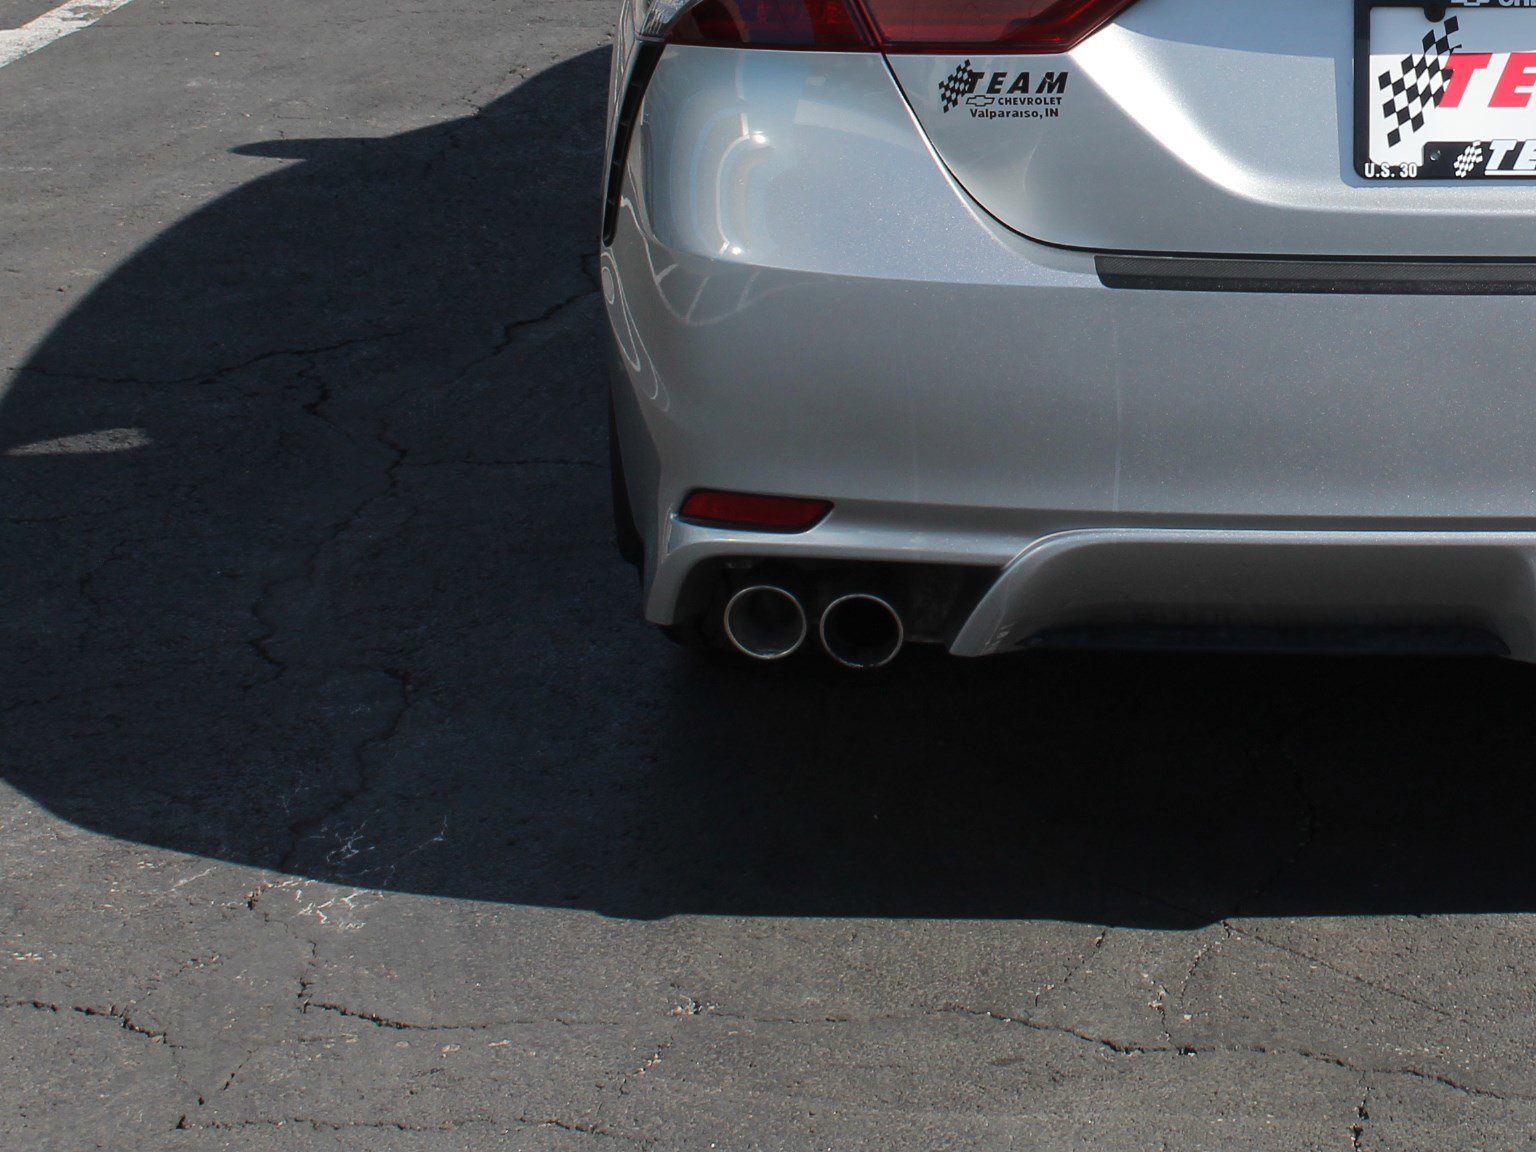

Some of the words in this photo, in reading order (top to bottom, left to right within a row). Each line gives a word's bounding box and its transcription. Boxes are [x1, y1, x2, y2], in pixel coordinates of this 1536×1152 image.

[967, 72, 1068, 94] TEAM
[998, 97, 1062, 105] CHEVROLET
[970, 108, 1043, 119] Valparaiso,
[1045, 108, 1059, 118] IN
[1364, 162, 1396, 178] U.S.
[1400, 162, 1418, 178] 30
